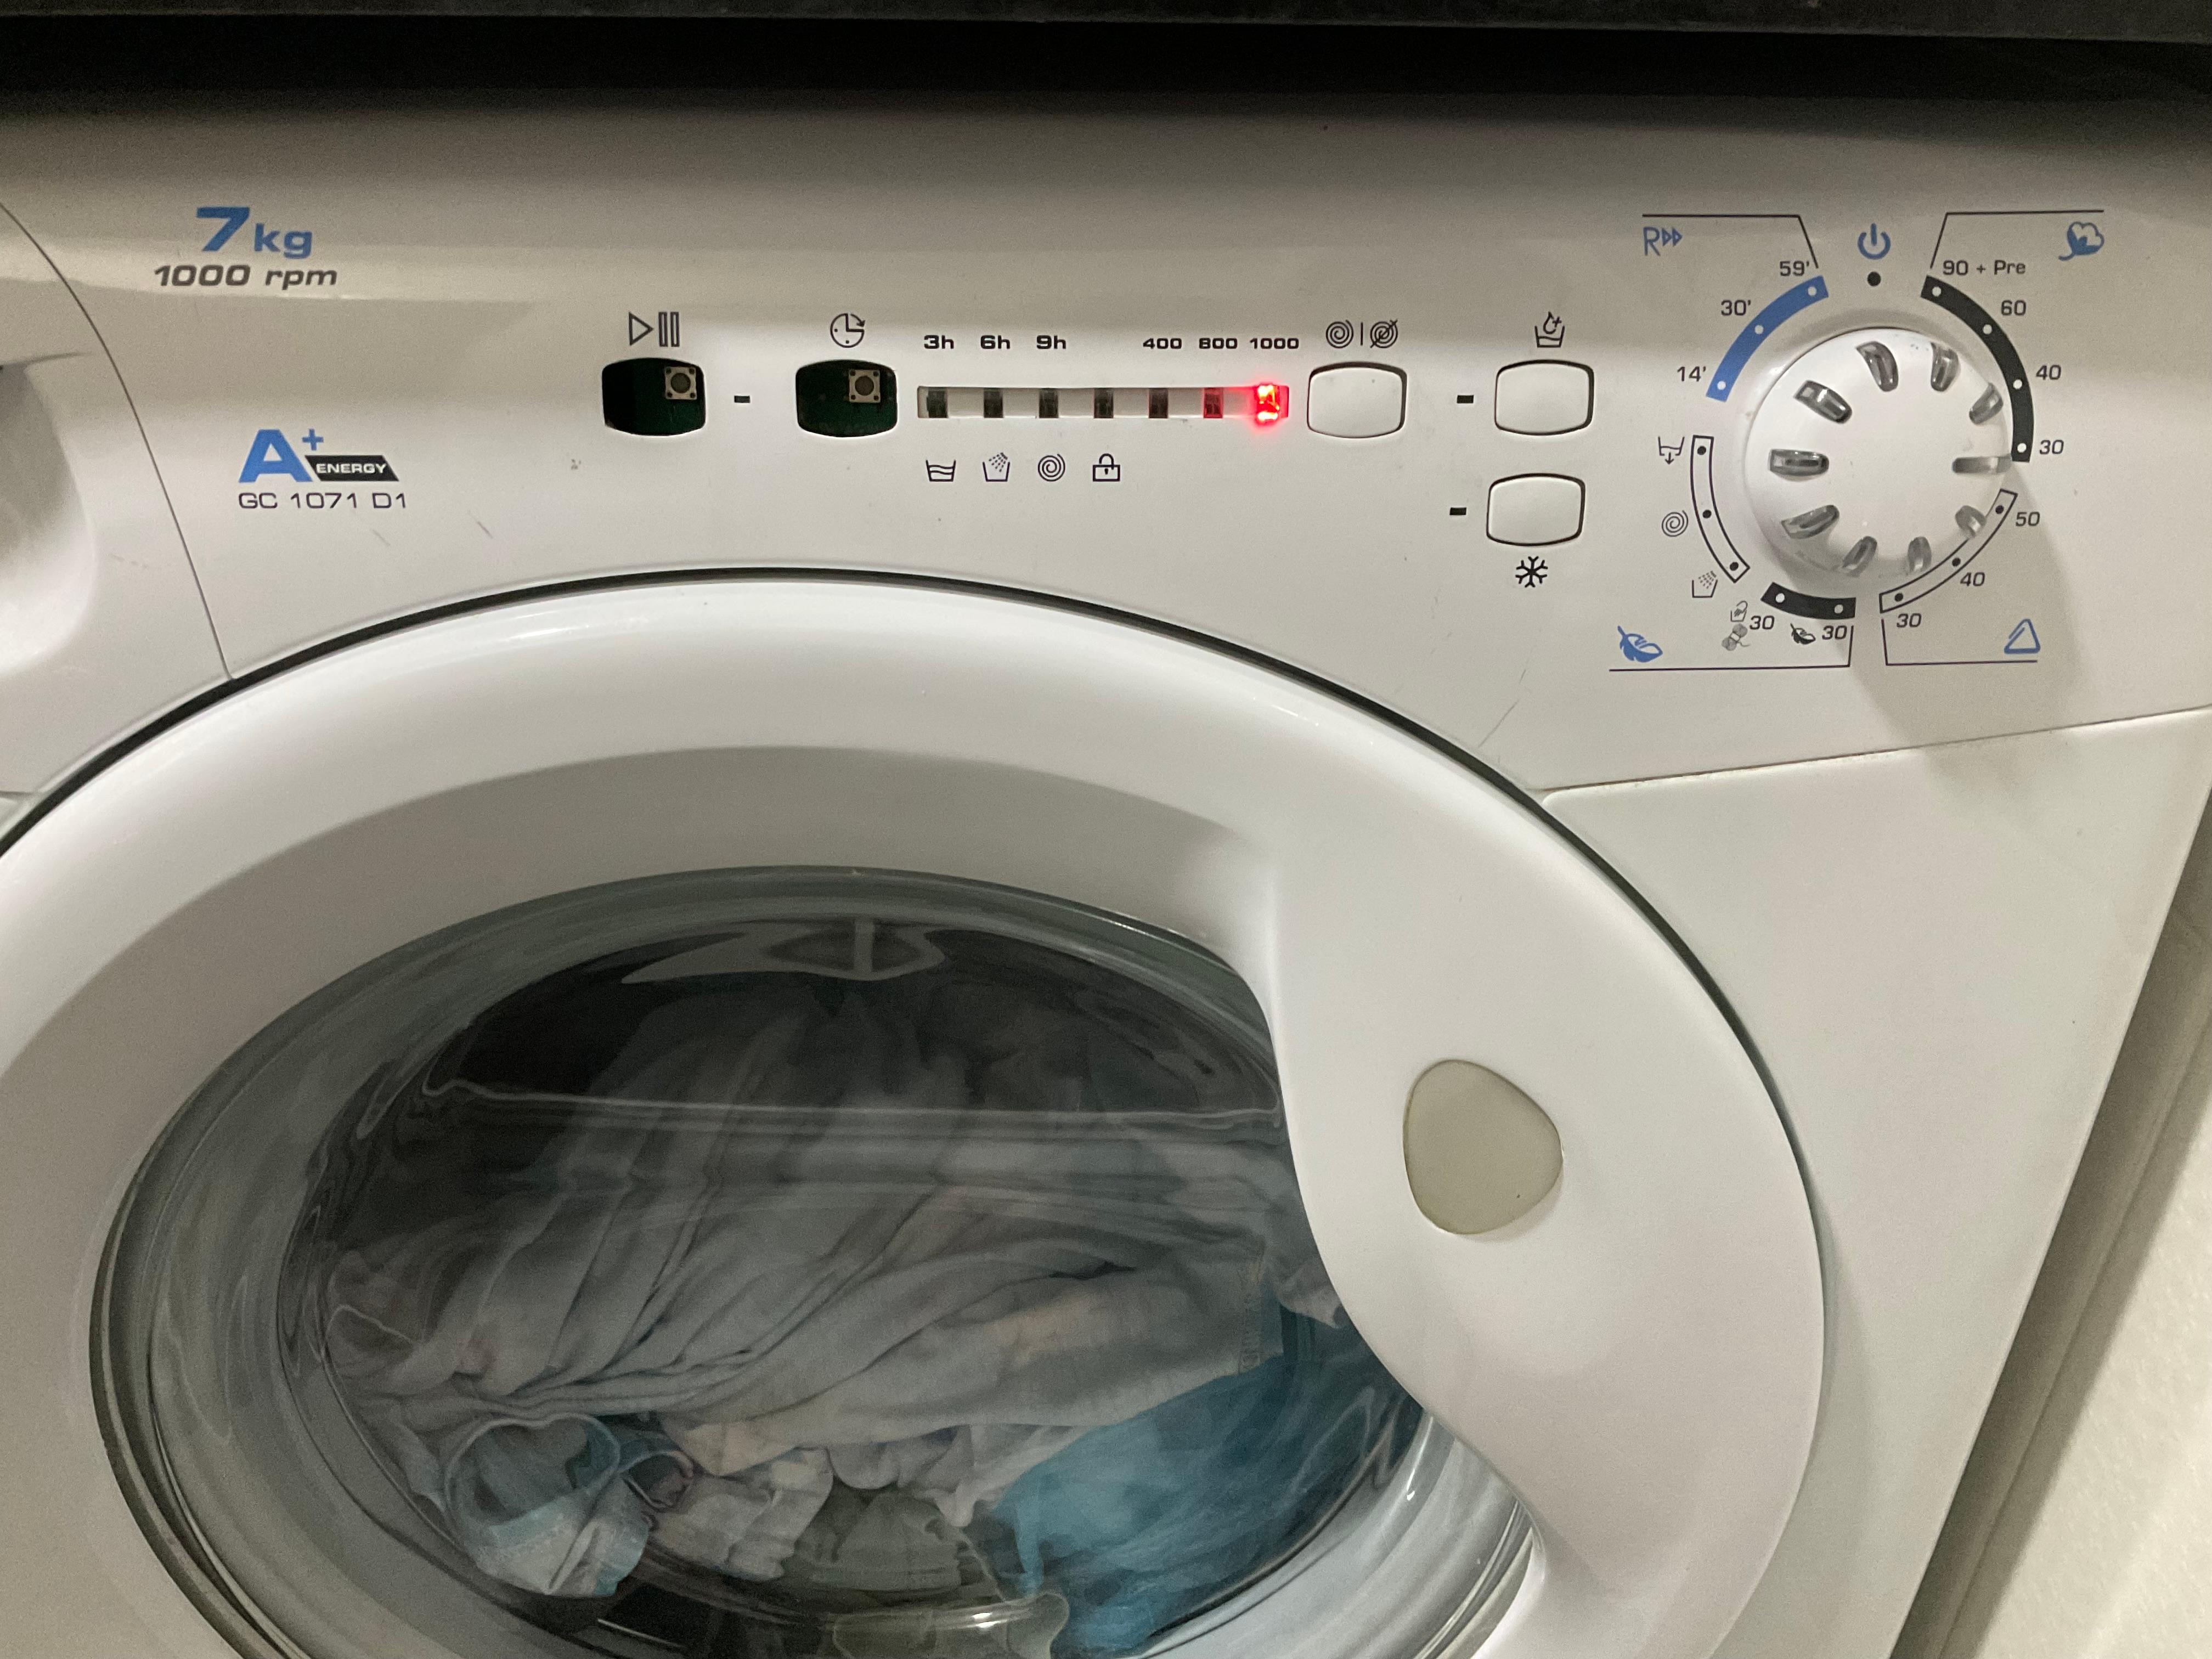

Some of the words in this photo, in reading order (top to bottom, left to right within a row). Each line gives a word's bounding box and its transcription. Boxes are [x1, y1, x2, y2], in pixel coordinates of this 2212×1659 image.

[1943, 260, 1969, 276] 90
[1994, 259, 2025, 275] Pre
[155, 264, 251, 286] 1000
[265, 270, 337, 291] rpm
[2001, 300, 2027, 316] 60
[924, 335, 954, 349] 3h
[980, 335, 1011, 349] 6h
[1036, 335, 1066, 349] 9h
[1143, 338, 1182, 349] 400
[1199, 337, 1238, 349] 800
[1250, 337, 1299, 349] 1000
[2036, 364, 2062, 380] 40
[2039, 439, 2064, 455] 30
[316, 463, 386, 473] ENERGY
[238, 492, 278, 509] GC
[290, 492, 357, 509] 1071
[372, 493, 405, 509] D1
[2016, 511, 2040, 527] 50
[1960, 572, 1985, 587] 40
[1749, 615, 1775, 630] 30
[1896, 613, 1922, 628] 30
[1822, 625, 1847, 640] 30
